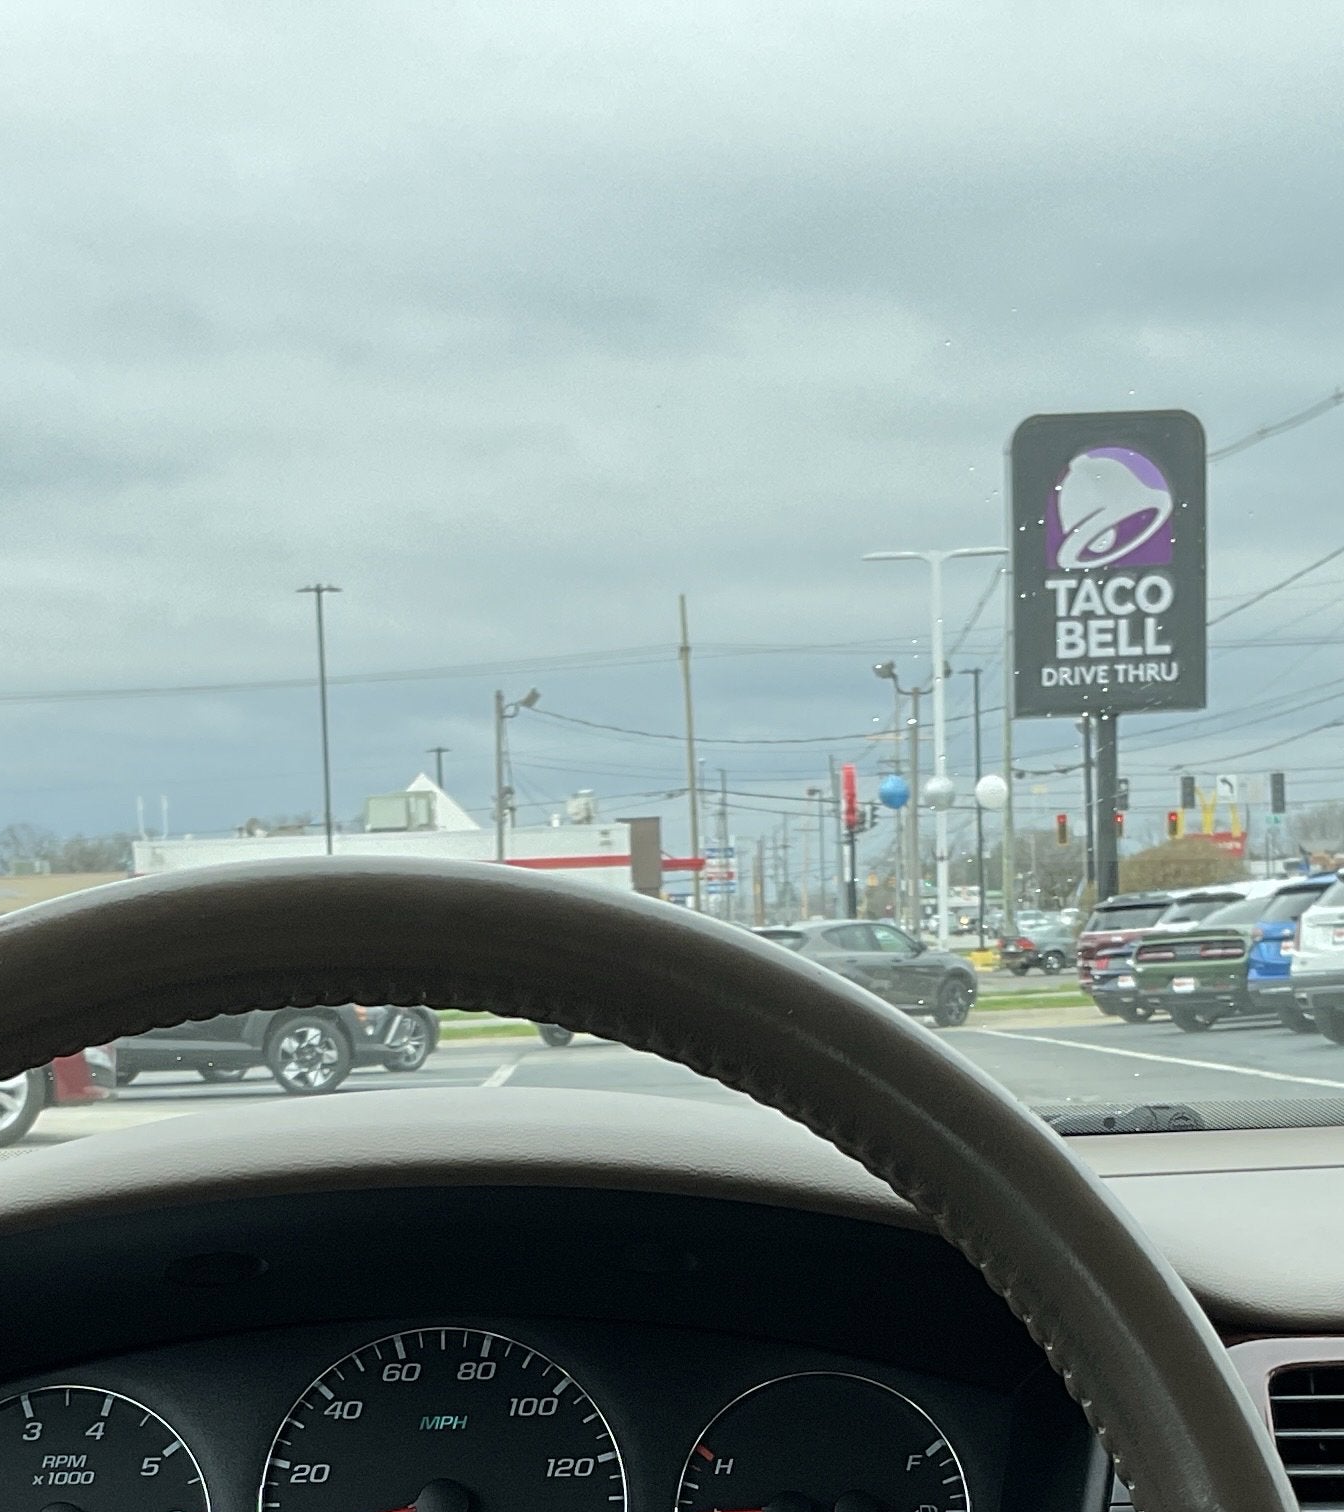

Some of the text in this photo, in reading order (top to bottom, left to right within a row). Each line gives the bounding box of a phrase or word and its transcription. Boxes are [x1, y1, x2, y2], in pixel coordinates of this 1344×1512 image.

[1044, 575, 1174, 617] TACO
[1056, 617, 1173, 659] BELL
[1041, 662, 1179, 687] DRIVE THRU
[382, 1362, 422, 1382] 60
[456, 1361, 497, 1381] 80
[323, 1400, 363, 1420] 40
[509, 1397, 559, 1417] 100
[22, 1421, 43, 1441] 3
[84, 1421, 105, 1440] 4
[419, 1415, 468, 1431] MPH
[41, 1454, 87, 1468] RPM
[140, 1456, 162, 1477] 5
[546, 1457, 595, 1478] 120
[714, 1458, 734, 1475] H
[906, 1455, 923, 1471] F
[289, 1463, 331, 1483] 20
